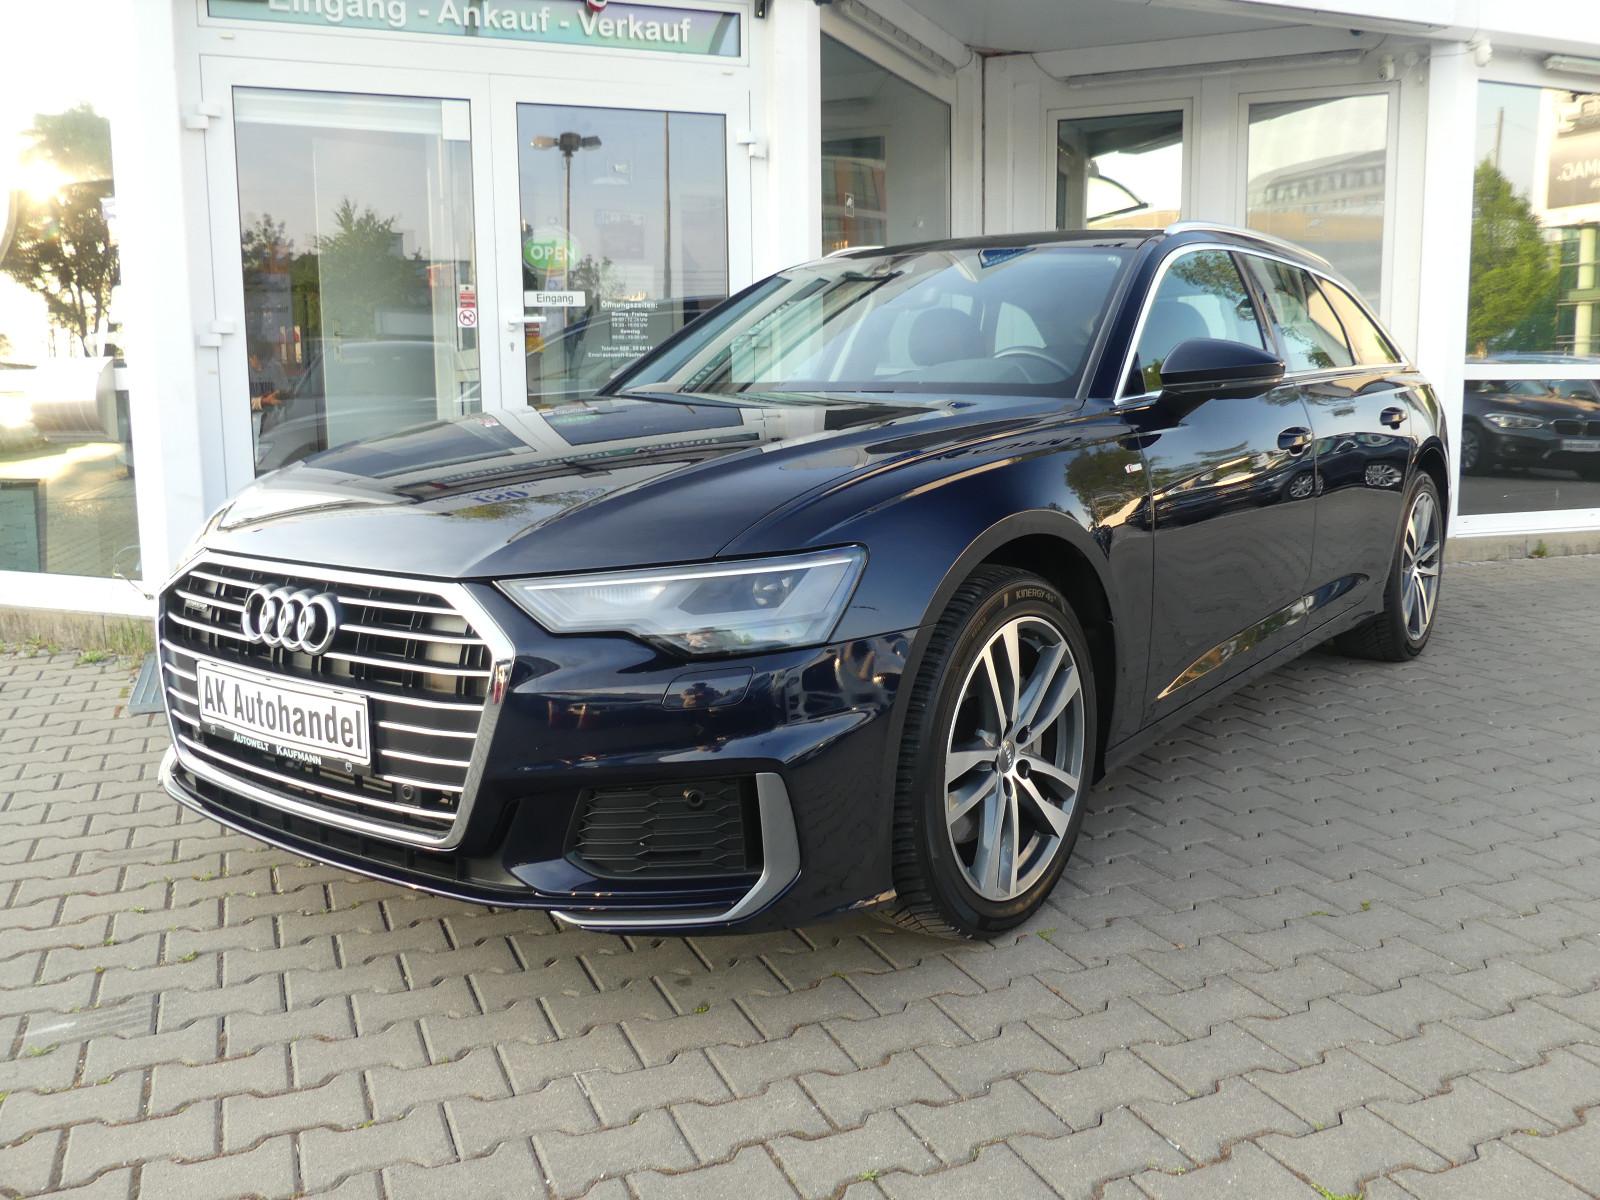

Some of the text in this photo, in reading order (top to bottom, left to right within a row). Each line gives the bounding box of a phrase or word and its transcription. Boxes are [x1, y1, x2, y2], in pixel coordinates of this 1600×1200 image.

[437, 0, 550, 32] Ankauf
[577, 8, 692, 43] Verkauf
[530, 245, 576, 260] OPEN
[536, 293, 574, 304] Eingang
[204, 674, 363, 750] AK Autohandel
[232, 731, 322, 766] AUTOWELT KAUFMANN
